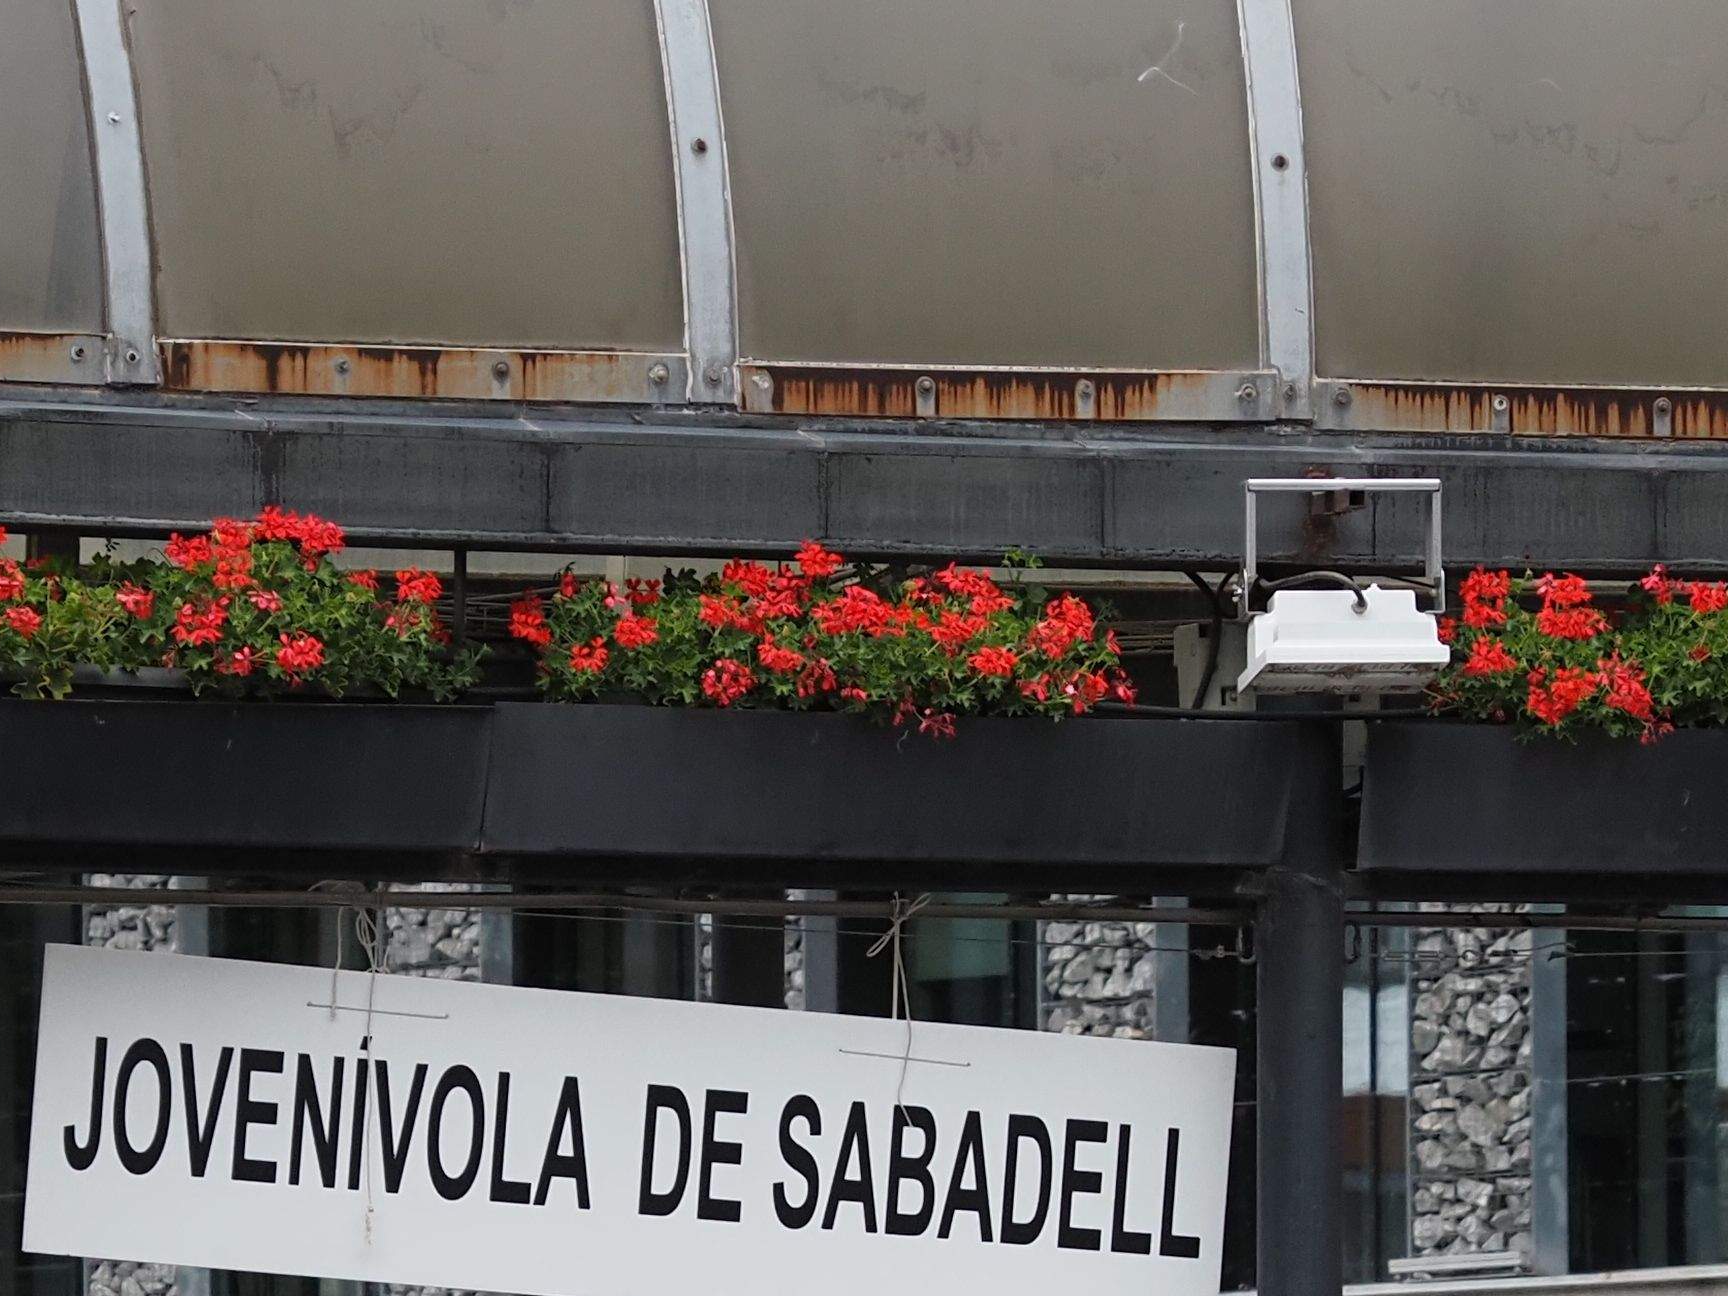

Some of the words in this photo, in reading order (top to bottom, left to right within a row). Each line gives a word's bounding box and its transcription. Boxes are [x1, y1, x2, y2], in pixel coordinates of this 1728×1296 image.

[64, 1035, 590, 1210] JOVENÍVOLA
[639, 1085, 748, 1222] DE
[773, 1095, 1200, 1259] SABADELL
